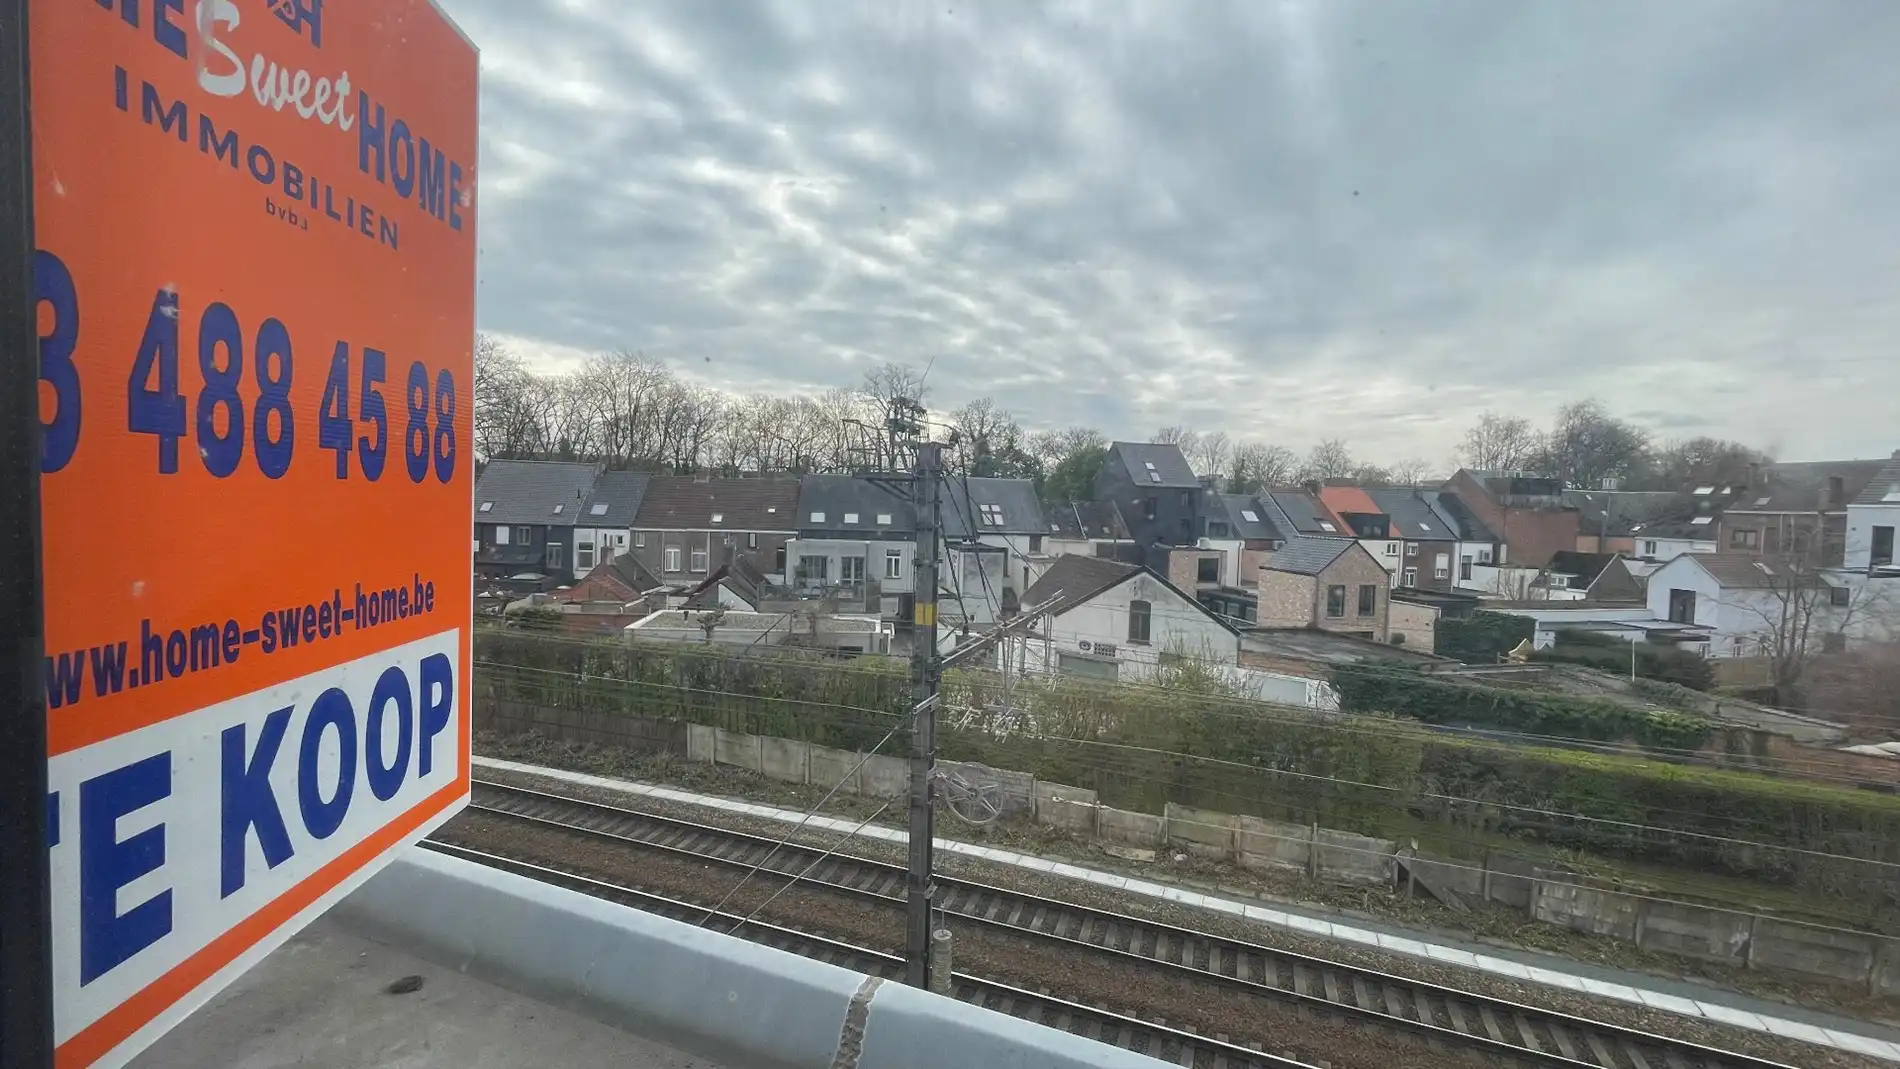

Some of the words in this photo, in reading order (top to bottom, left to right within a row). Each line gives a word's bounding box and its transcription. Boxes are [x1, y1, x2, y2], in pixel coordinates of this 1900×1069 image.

[114, 64, 399, 251] IMMOBILIEN
[197, 0, 355, 131] Sweet
[358, 89, 462, 232] HOME
[128, 287, 294, 479] 488
[318, 340, 388, 482] 45
[405, 360, 456, 484] 88
[47, 749, 173, 988] E
[220, 652, 454, 901] KOOP
